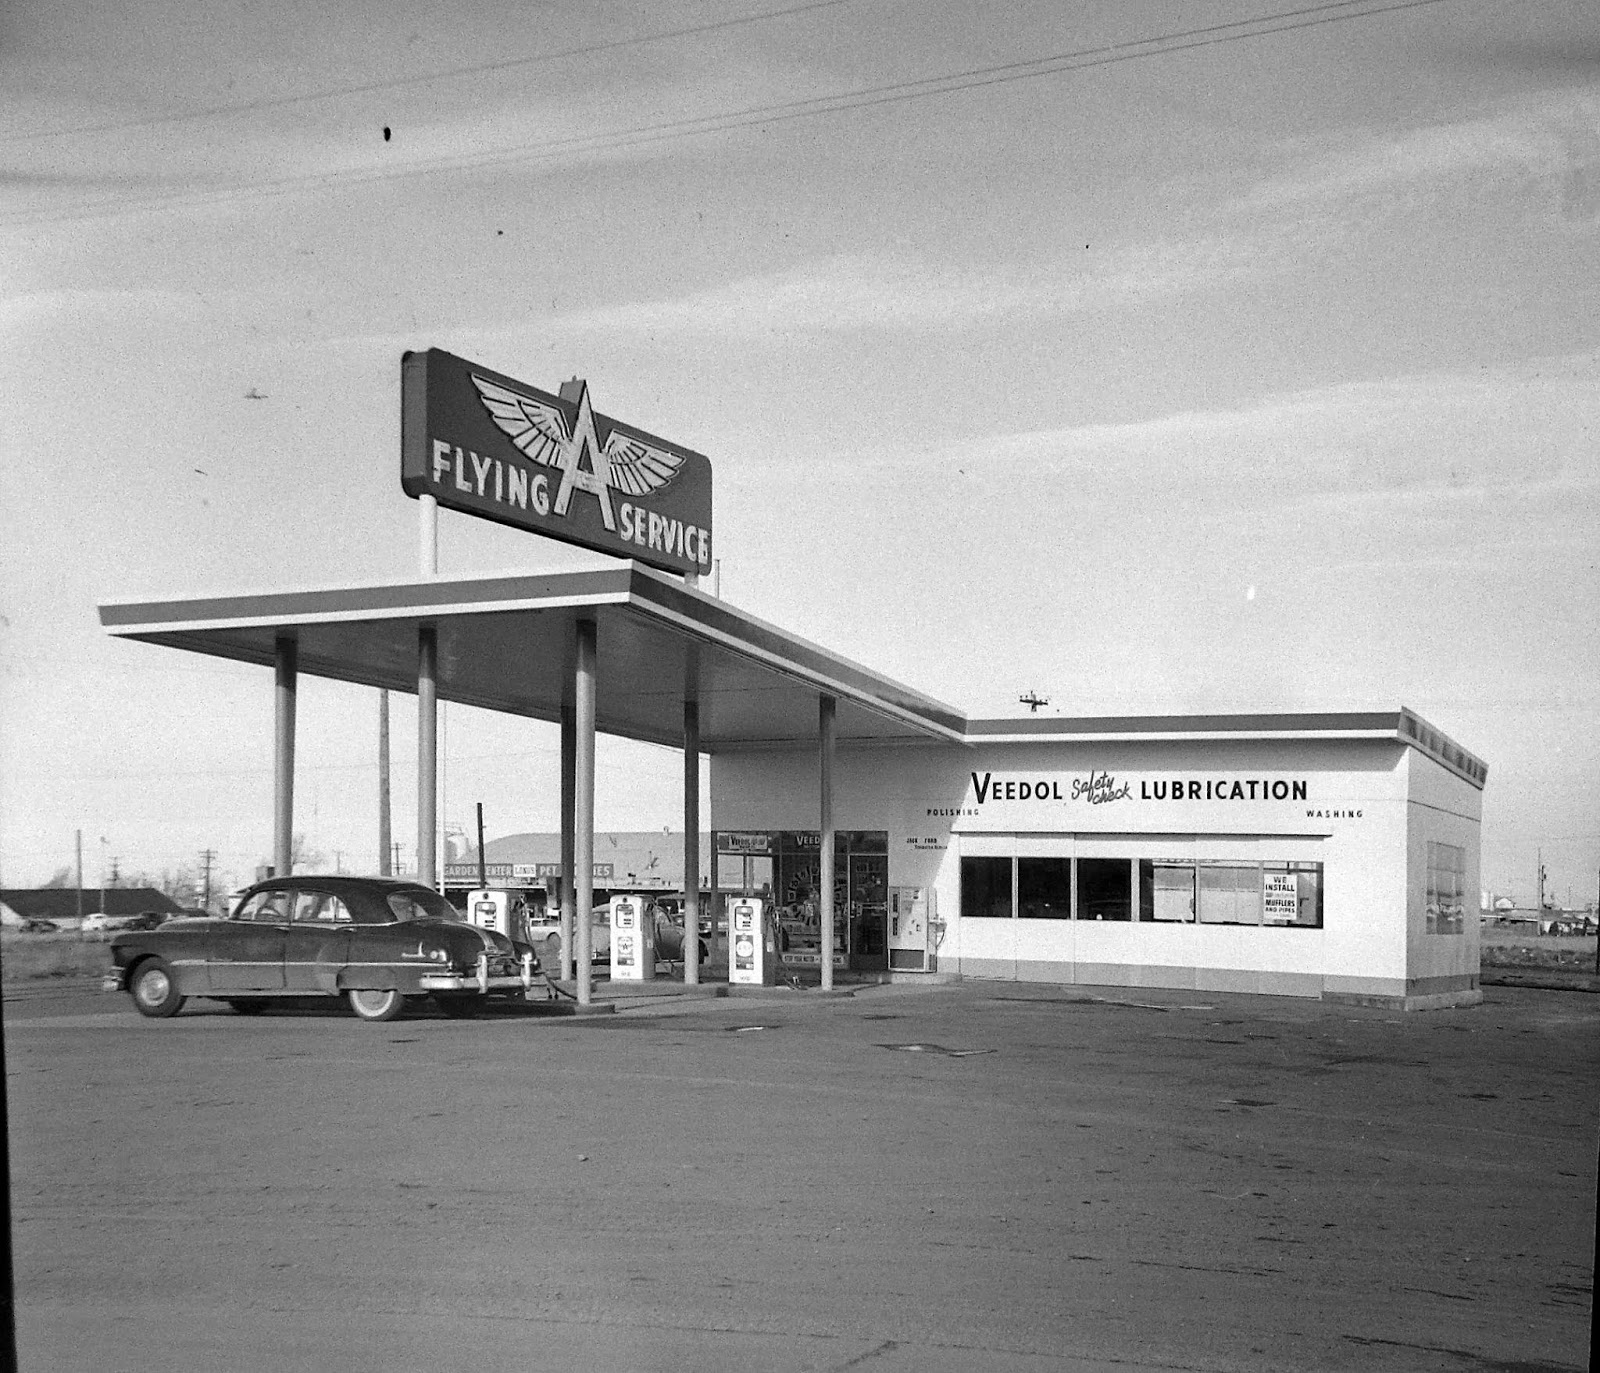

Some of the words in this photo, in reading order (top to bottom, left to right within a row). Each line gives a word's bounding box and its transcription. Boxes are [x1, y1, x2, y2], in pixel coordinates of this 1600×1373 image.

[432, 438, 550, 516] FLYING
[553, 379, 617, 532] A
[620, 502, 710, 565] SERVICE
[971, 771, 1063, 804] VEEDOL
[1071, 769, 1115, 802] Safety
[1141, 780, 1308, 801] LUBRICATION
[926, 808, 980, 817] POLISHING
[1306, 809, 1364, 819] WASHING
[796, 835, 821, 847] VEED
[485, 864, 513, 877] ENTER
[539, 865, 558, 876] PET
[1273, 876, 1287, 884] WE
[1265, 899, 1296, 907] MUFFLERS
